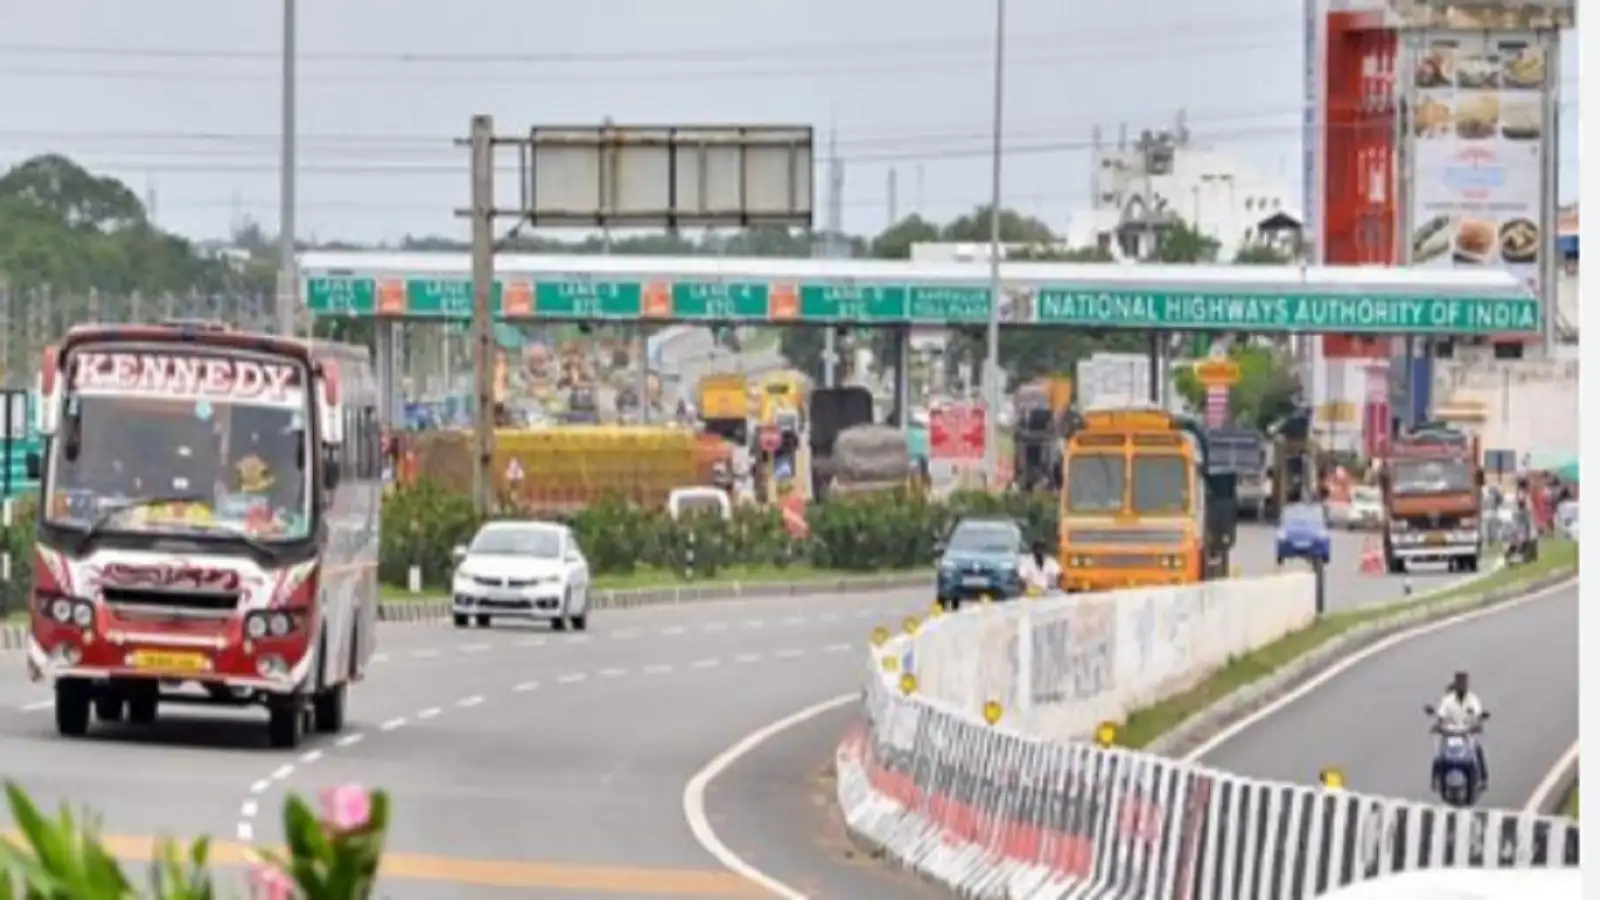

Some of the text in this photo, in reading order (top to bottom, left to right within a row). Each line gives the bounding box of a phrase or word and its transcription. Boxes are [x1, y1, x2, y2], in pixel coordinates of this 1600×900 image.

[1042, 294, 1534, 328] NATIONAL HIGHWAYS AUTHORITY OF INDIA
[75, 352, 294, 401] KENNEDY
